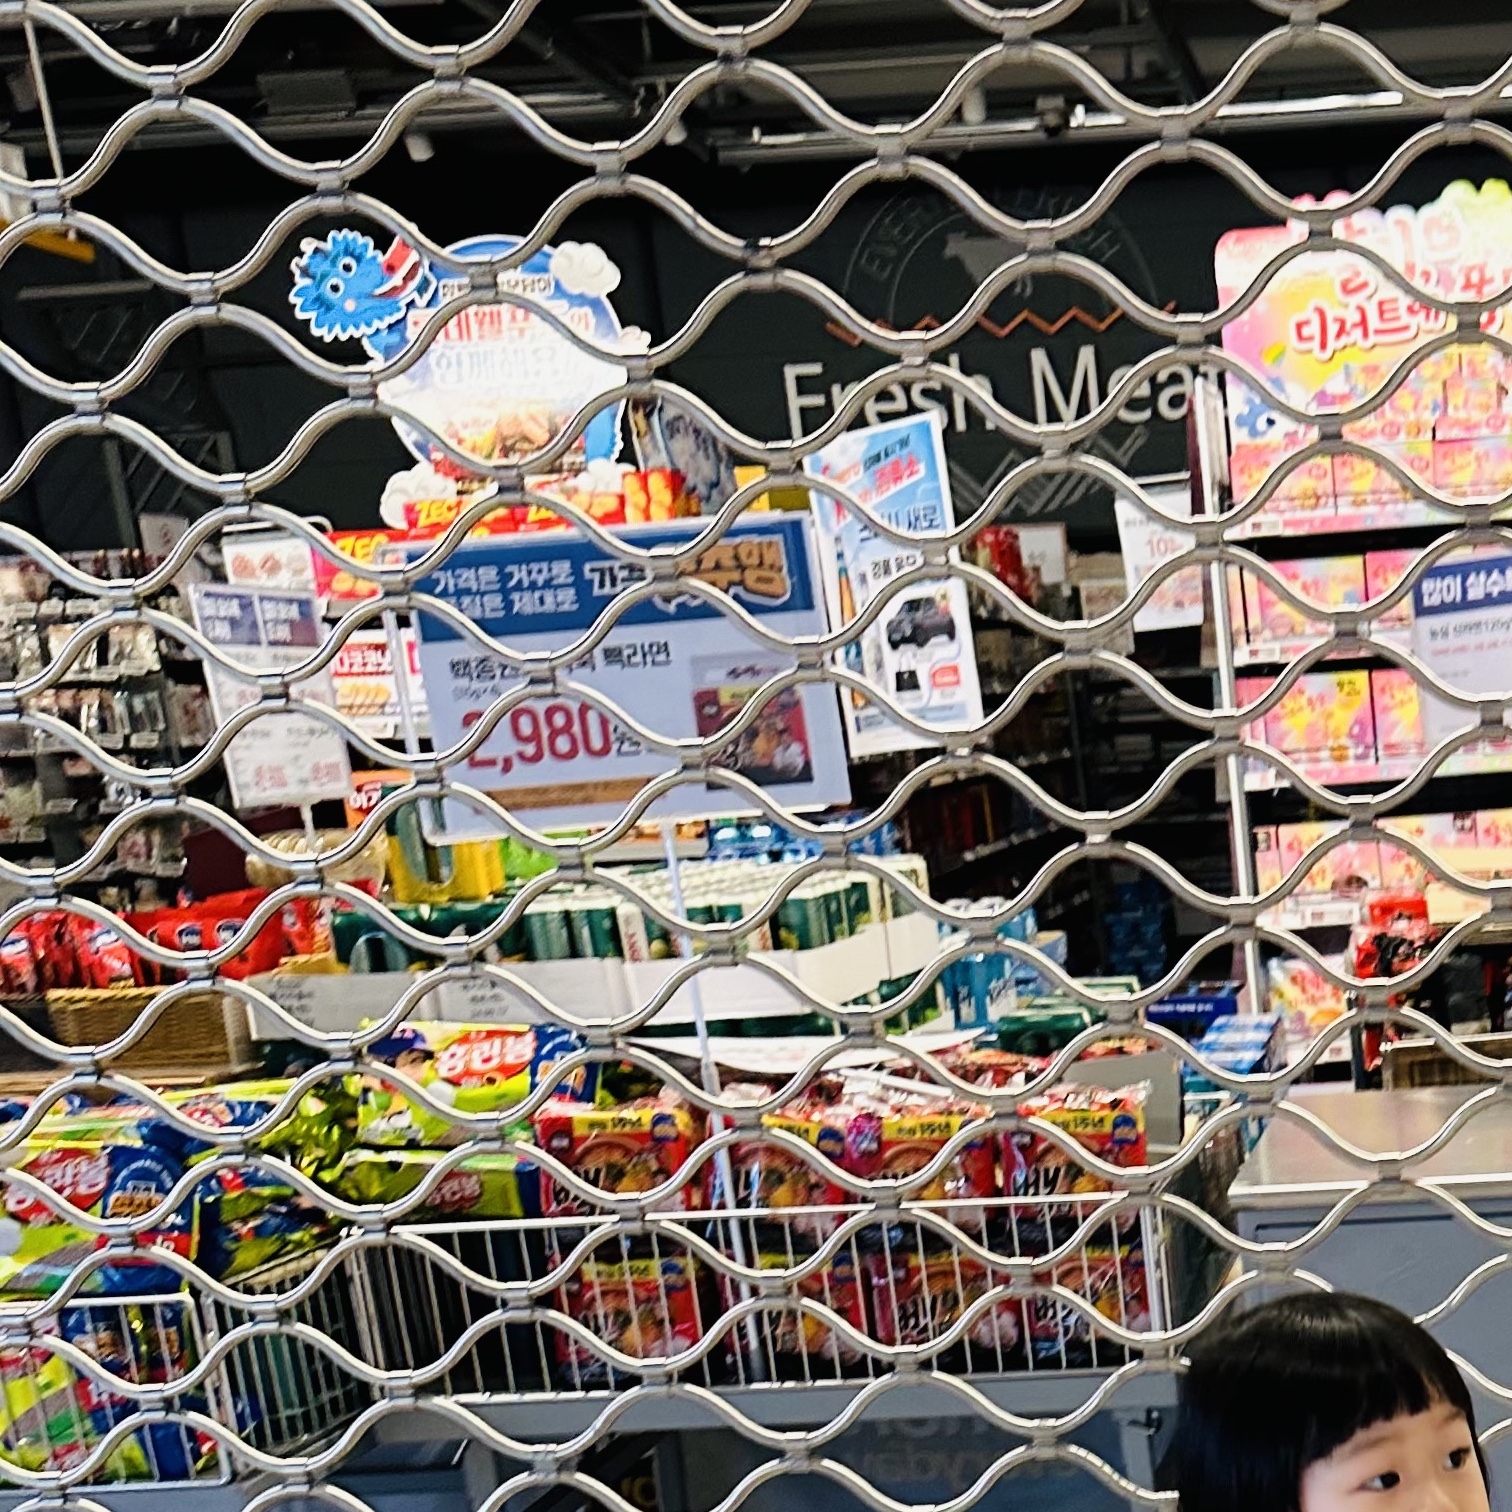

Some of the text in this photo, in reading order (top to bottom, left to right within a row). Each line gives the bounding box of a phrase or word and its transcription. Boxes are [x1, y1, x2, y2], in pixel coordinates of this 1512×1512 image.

[784, 344, 1227, 440] Fresh Mea
[431, 559, 575, 596] 가격은 거꾸로
[1421, 573, 1462, 607] 많이
[443, 587, 580, 620] 질은 제대로
